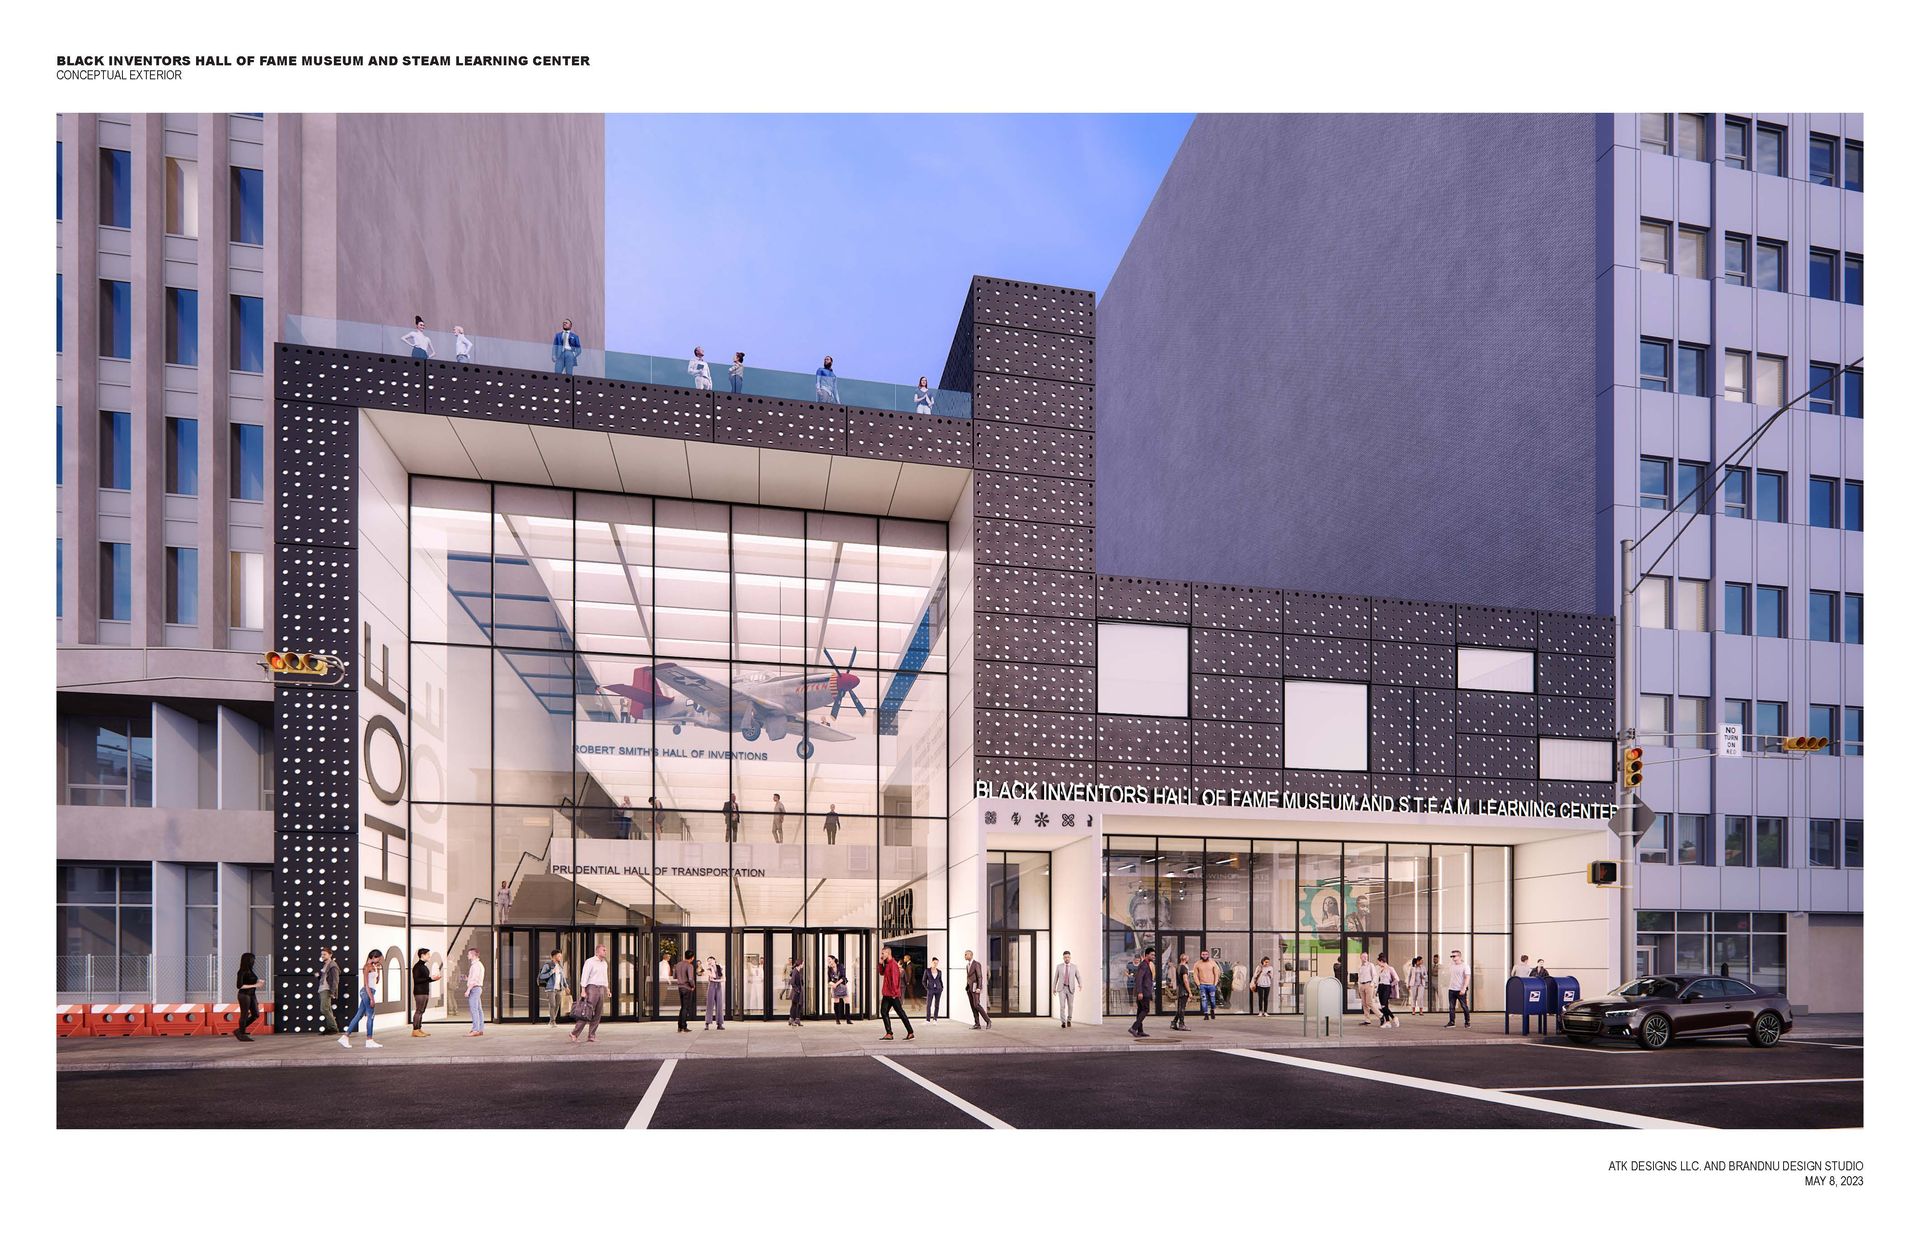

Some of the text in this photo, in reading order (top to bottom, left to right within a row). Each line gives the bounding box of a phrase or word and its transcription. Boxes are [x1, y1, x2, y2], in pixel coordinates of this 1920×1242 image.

[574, 744, 616, 755] ROBERT
[662, 748, 688, 758] HALL
[690, 749, 704, 759] OF
[708, 750, 768, 760] INVENTIONS
[976, 781, 1038, 800] BLACK
[1043, 782, 1149, 804] INVENTORS
[1154, 787, 1197, 806] HALL
[1202, 789, 1227, 807] OF
[1231, 790, 1280, 809] FAME
[1283, 792, 1356, 812] MUSEUM
[1360, 795, 1395, 813] AND
[1399, 797, 1474, 816] S.T.E.A.M.
[1479, 800, 1556, 818] LEARNING
[552, 864, 766, 878] PRUDENTIAL HALL OF TRANSPORTATION
